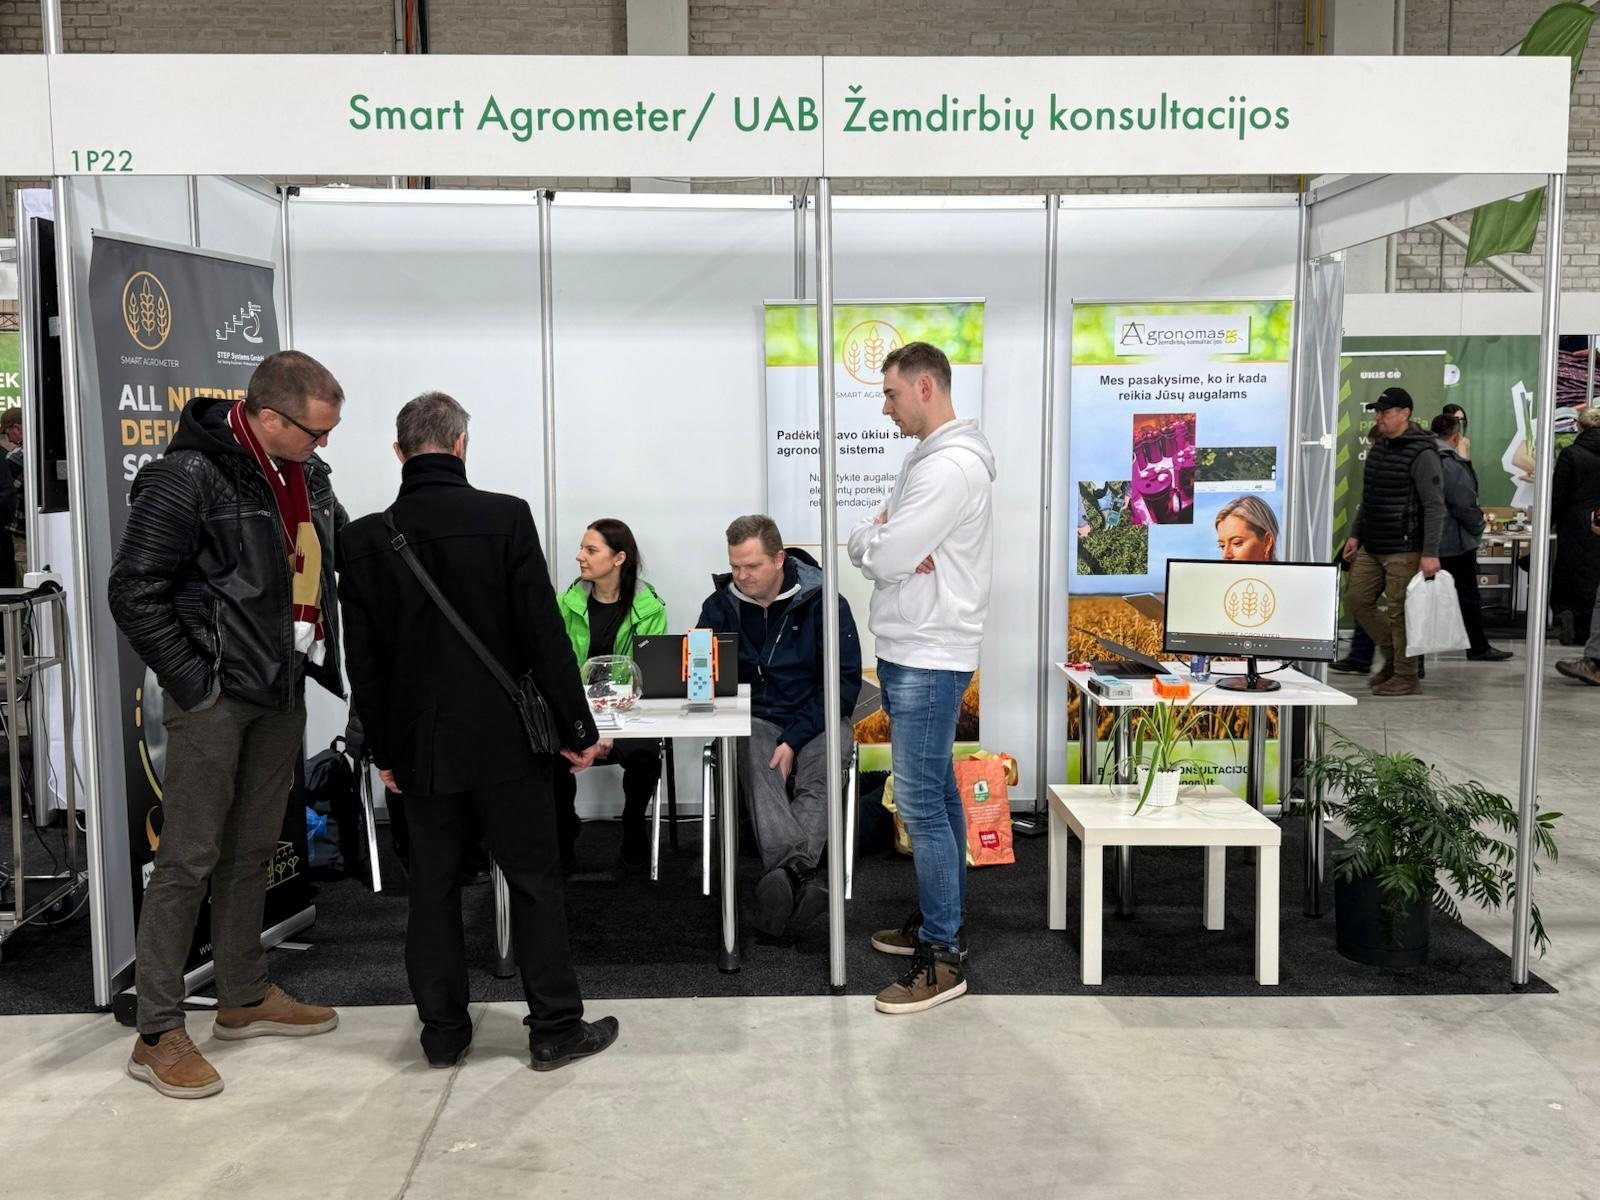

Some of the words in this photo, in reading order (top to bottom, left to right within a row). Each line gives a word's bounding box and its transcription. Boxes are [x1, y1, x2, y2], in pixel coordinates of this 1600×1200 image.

[349, 93, 464, 131] Smart
[476, 92, 716, 143] Agrometer/
[733, 96, 820, 132] UAB
[842, 84, 1035, 140] Žemdirbių
[1049, 92, 1291, 141] konsultacijos
[71, 150, 134, 172] 1P22
[1120, 321, 1226, 346] Agronomas
[120, 355, 143, 366] SMART
[143, 357, 180, 369] AGROMETER
[216, 351, 231, 360] STEP
[1100, 375, 1125, 386] Mes
[1128, 374, 1204, 388] pasakysime,
[1207, 374, 1223, 385] ko
[1226, 373, 1235, 384] ir
[1238, 373, 1267, 384] kada
[118, 384, 162, 412] ALL
[835, 391, 861, 399] SMART
[1118, 389, 1152, 401] reikia
[1155, 389, 1185, 403] Jūsų
[1188, 389, 1248, 403] augalams
[121, 419, 180, 446] DEFI
[776, 430, 821, 441] Padėkit
[836, 431, 858, 440] avo
[776, 446, 821, 457] agrono
[839, 445, 885, 455] sistema
[863, 473, 898, 484] augala
